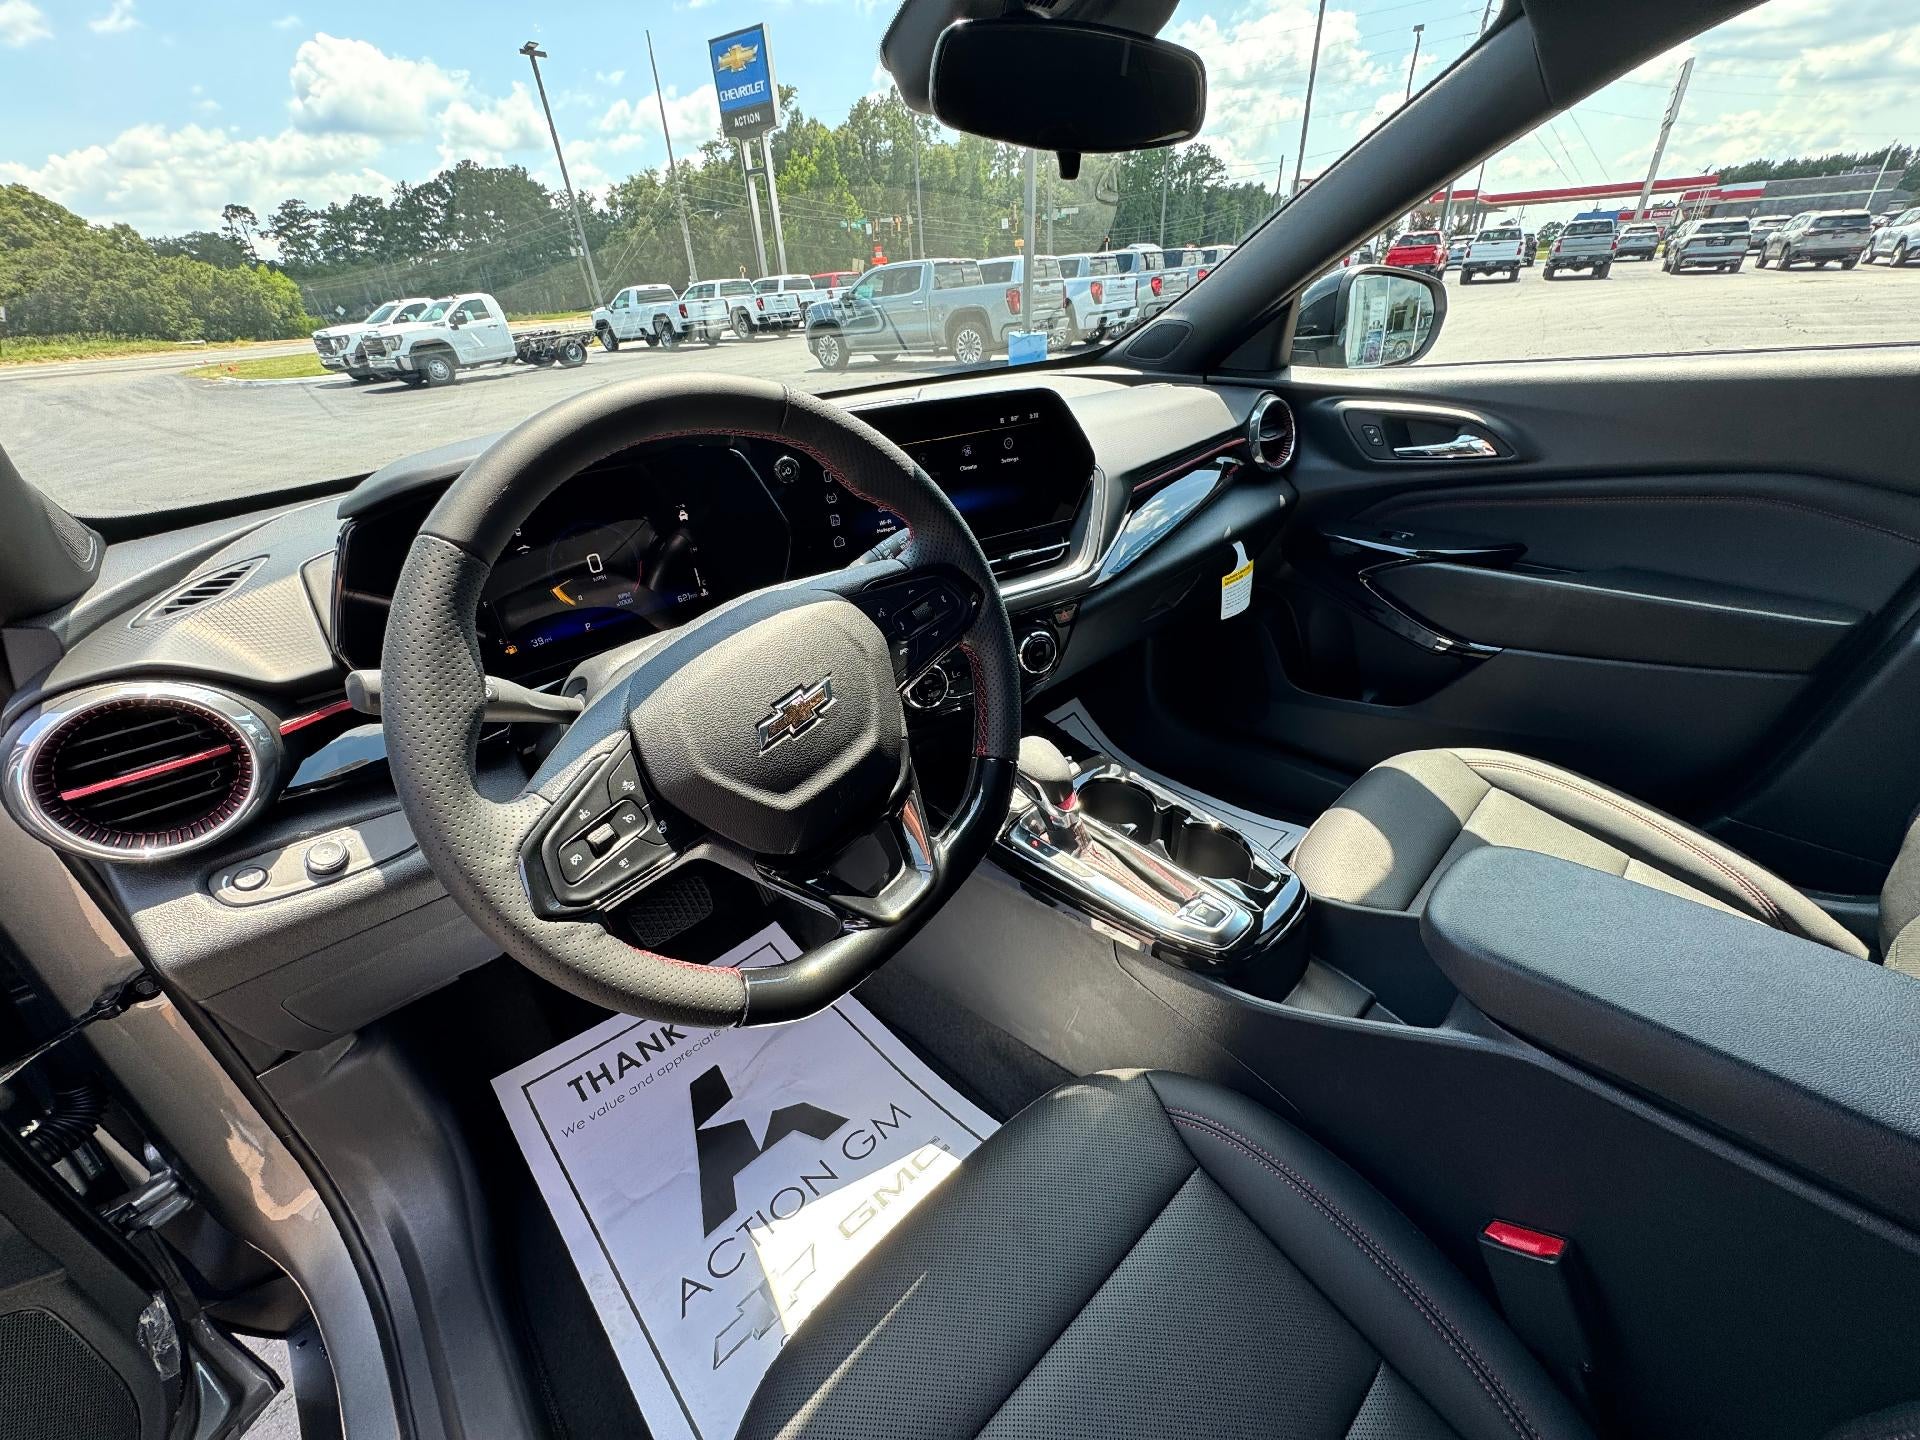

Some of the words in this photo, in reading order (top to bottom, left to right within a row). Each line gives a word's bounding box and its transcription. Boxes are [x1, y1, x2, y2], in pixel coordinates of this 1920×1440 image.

[720, 80, 765, 102] CHEVROLET
[734, 112, 760, 127] ACTION
[618, 857, 629, 868] SET
[561, 1119, 586, 1138] We
[589, 1094, 625, 1121] value
[628, 1072, 655, 1096] and
[657, 1029, 721, 1077] appreciate
[567, 1024, 688, 1102] THANK
[681, 1159, 839, 1319] ACTION
[842, 1103, 912, 1162] GM
[838, 1136, 950, 1239] GMC
